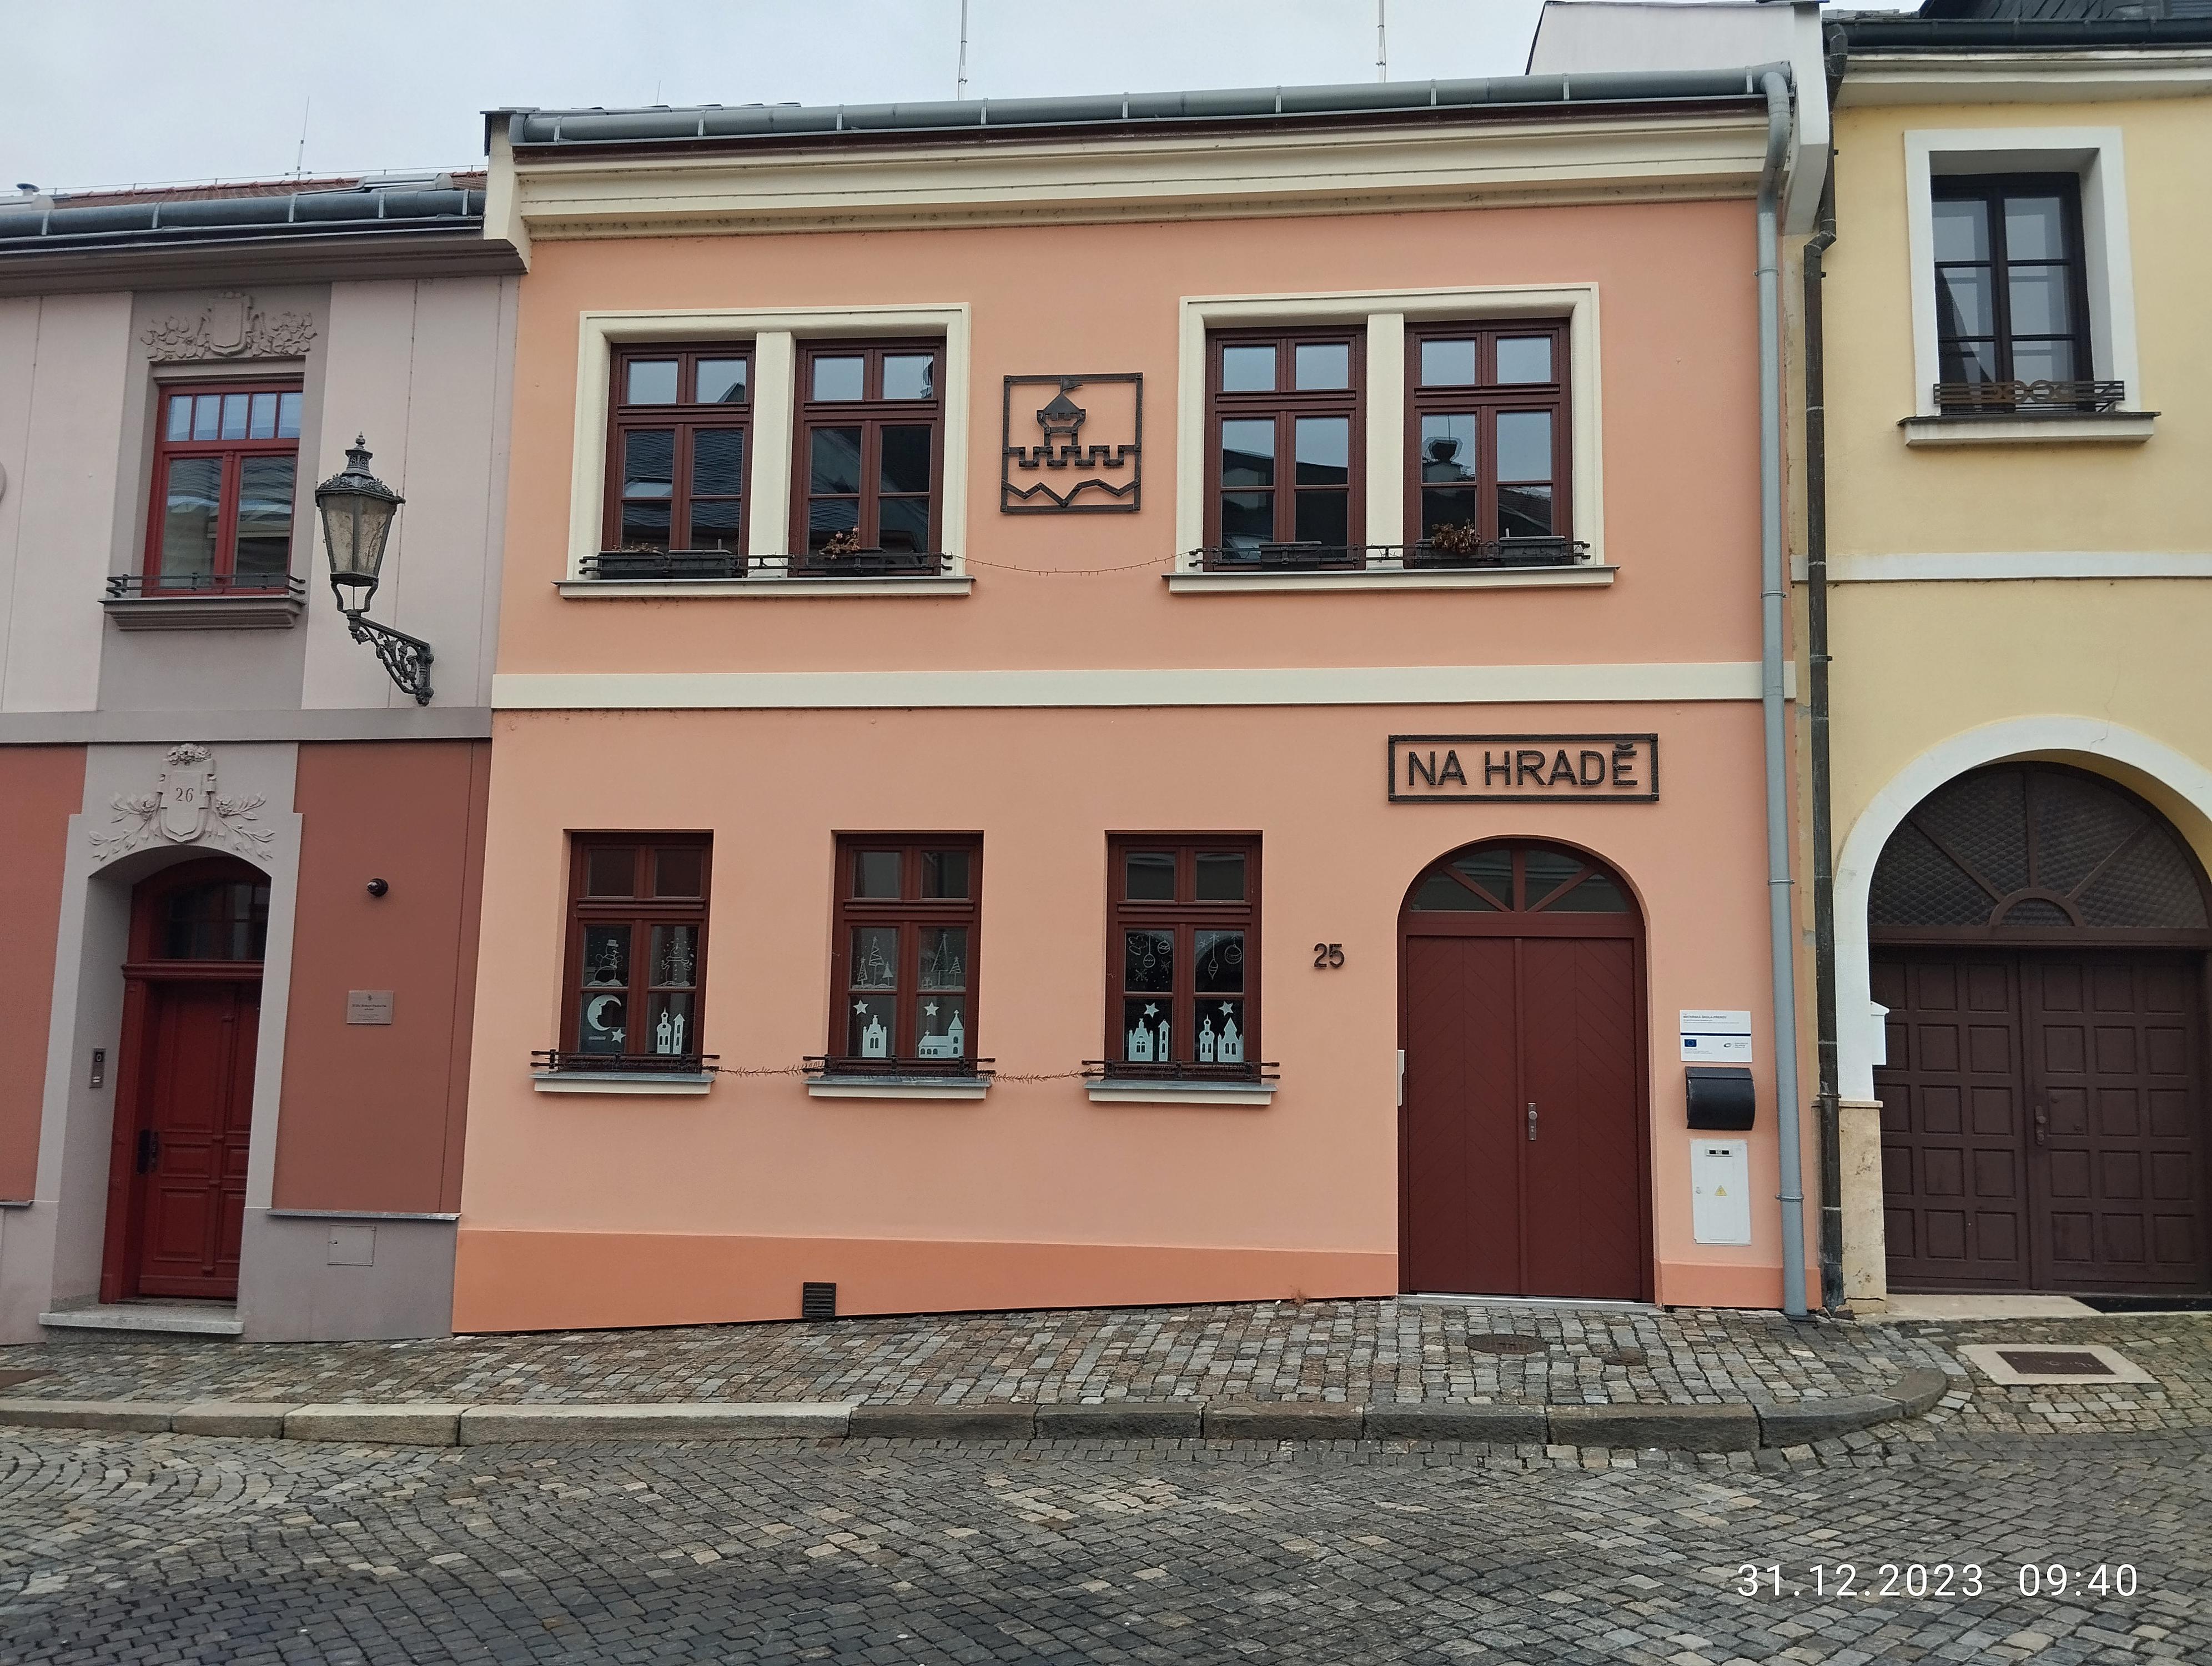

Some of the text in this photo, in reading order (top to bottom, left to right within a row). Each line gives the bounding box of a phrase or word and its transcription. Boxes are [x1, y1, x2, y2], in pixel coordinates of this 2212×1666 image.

[1408, 742, 1638, 786] NA HRADĚ
[175, 787, 194, 802] 26
[1314, 943, 1344, 968] 25
